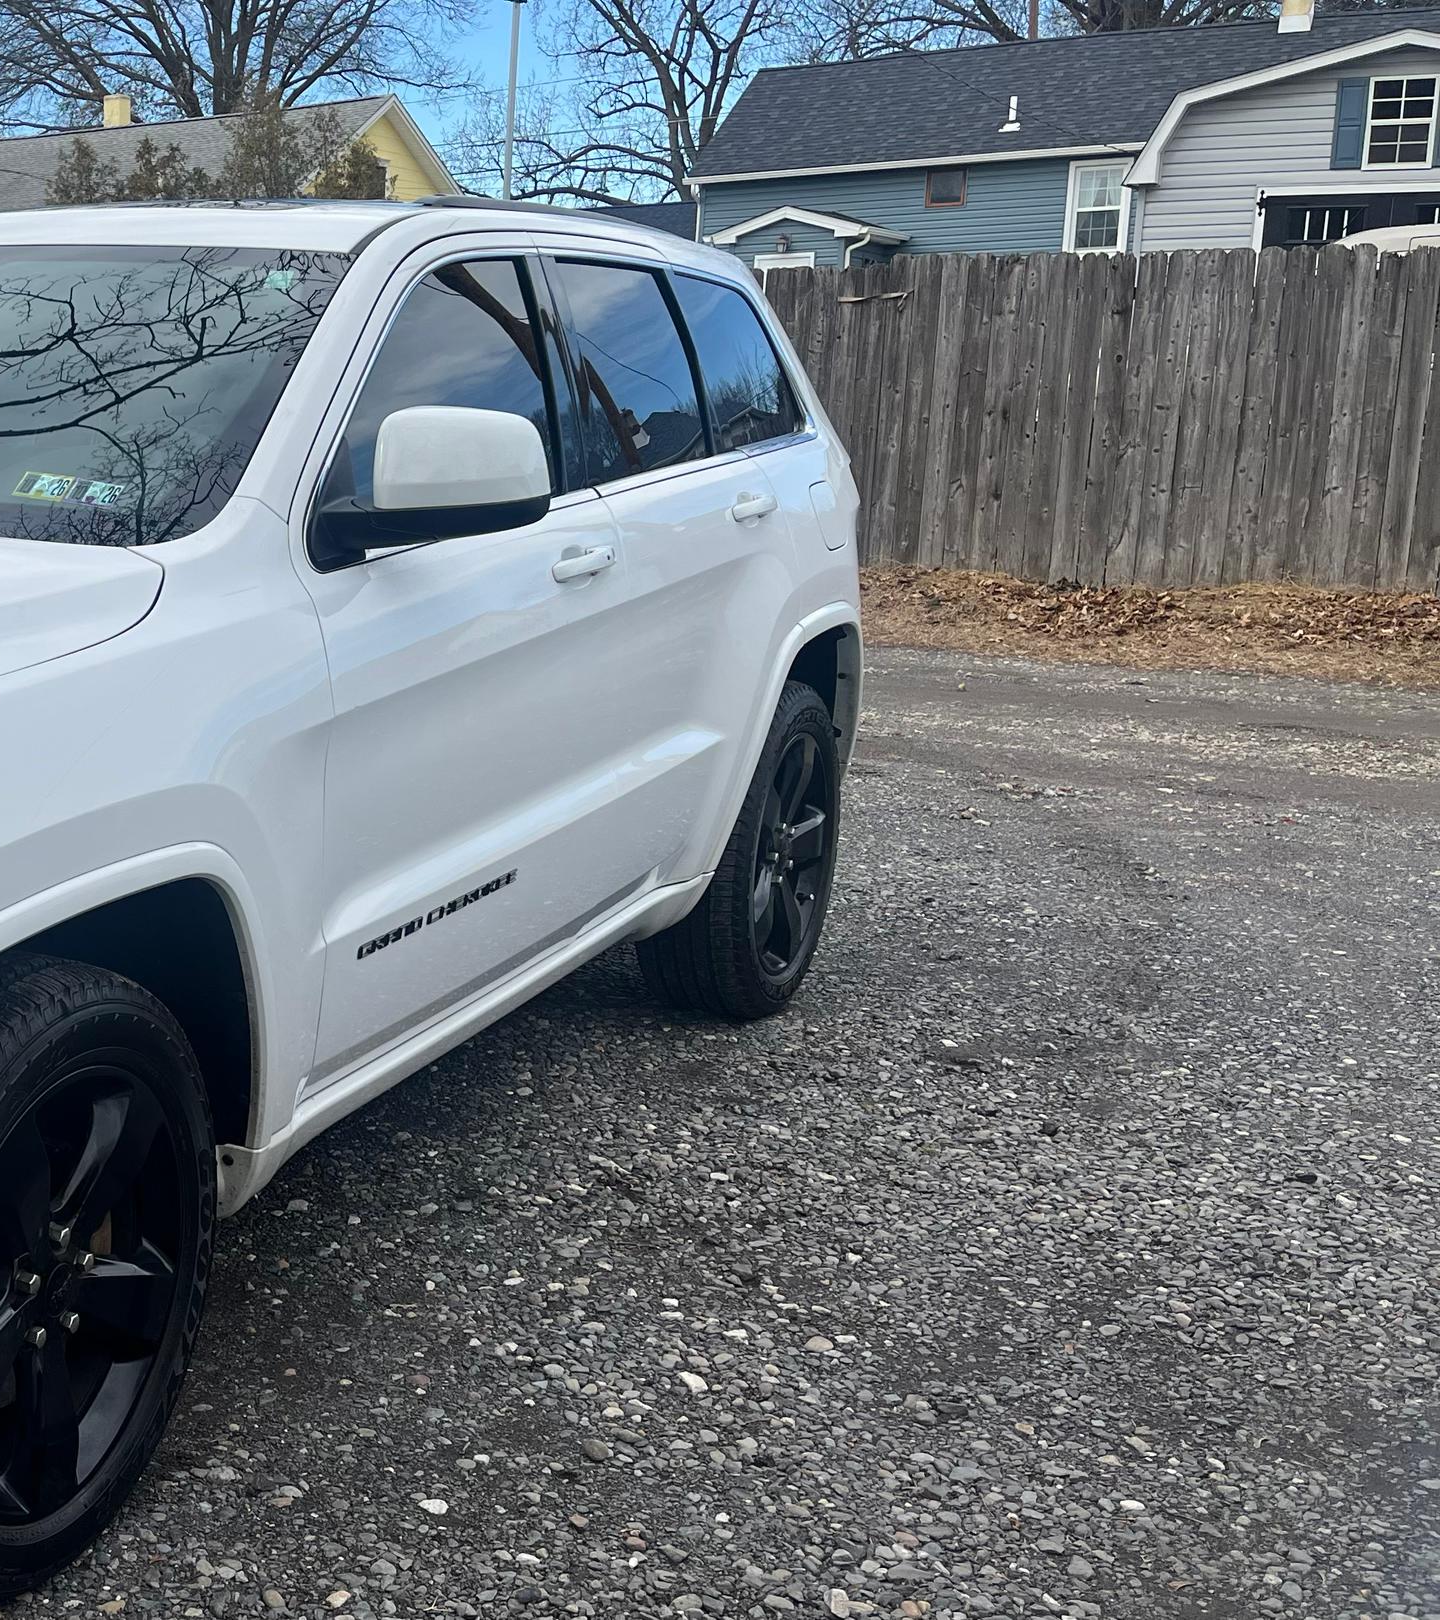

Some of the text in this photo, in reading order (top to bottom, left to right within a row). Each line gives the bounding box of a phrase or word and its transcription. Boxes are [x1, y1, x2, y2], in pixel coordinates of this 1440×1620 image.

[50, 479, 70, 497] 26
[101, 486, 122, 503] 26
[357, 916, 423, 960] GRAND
